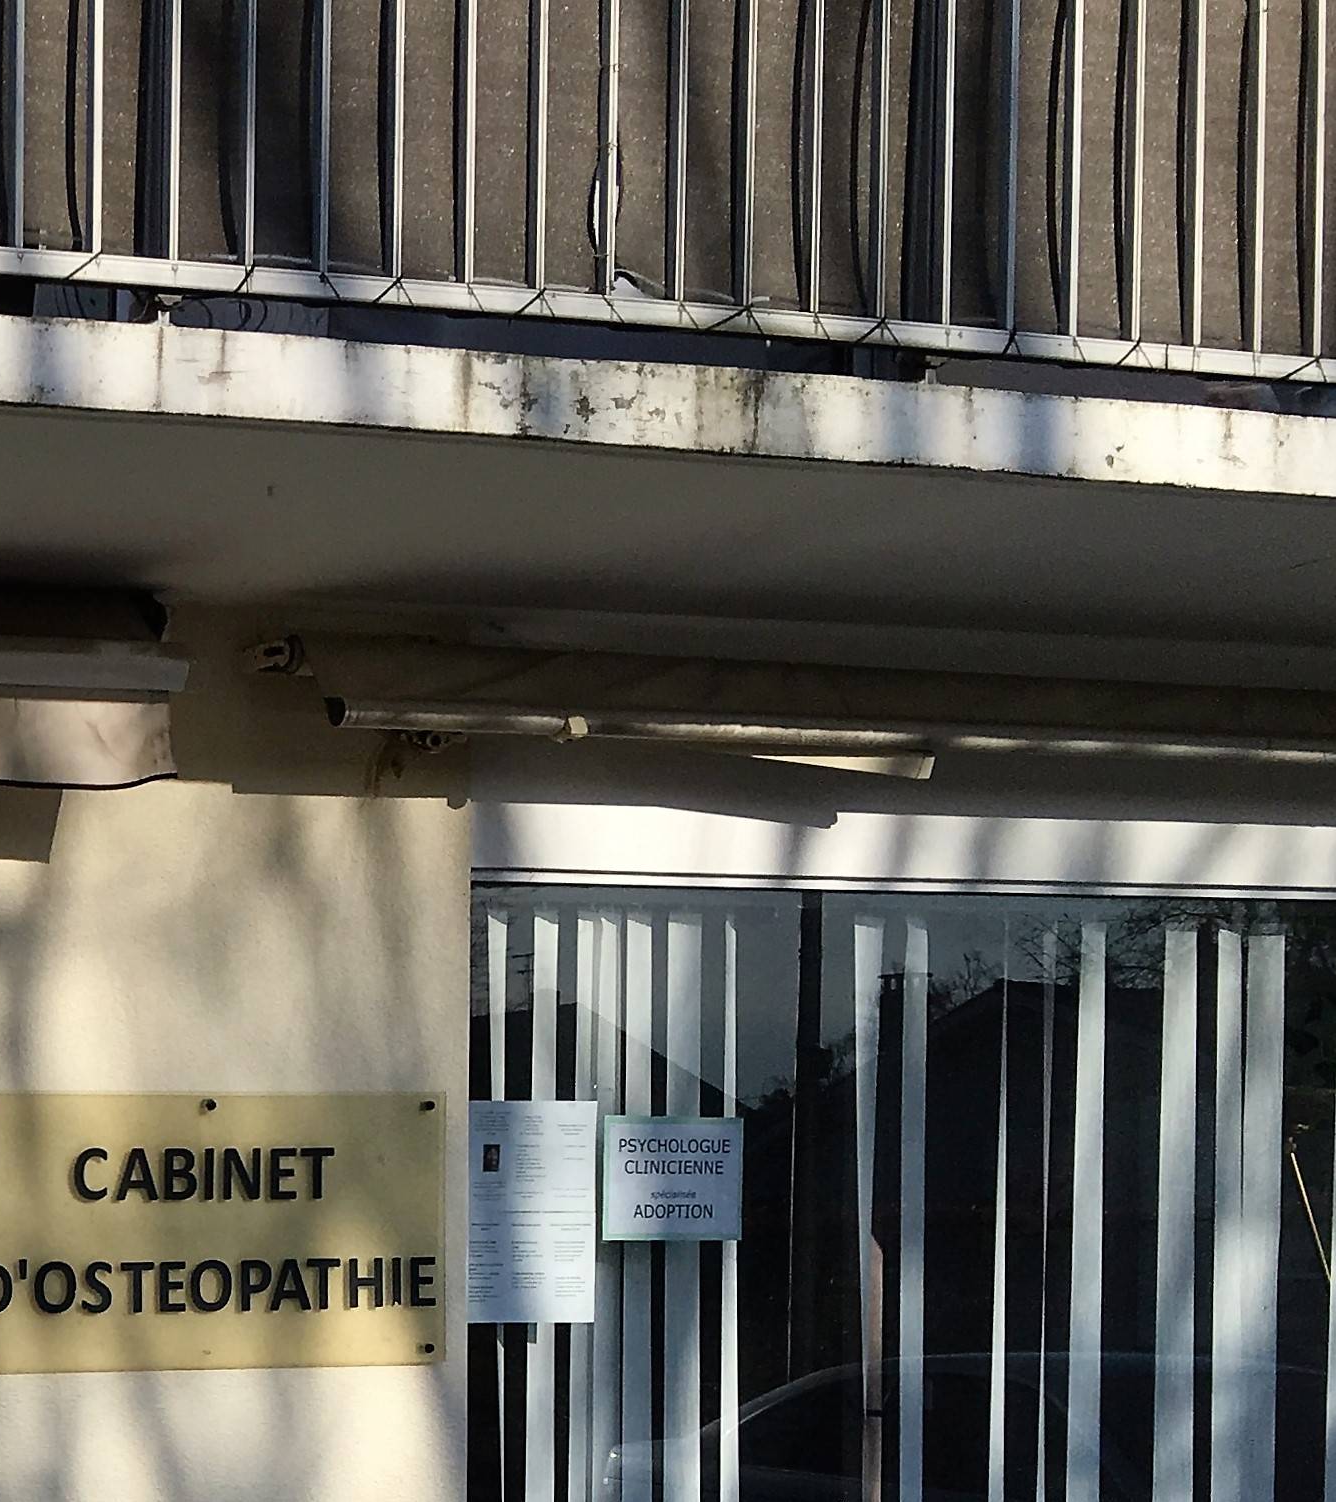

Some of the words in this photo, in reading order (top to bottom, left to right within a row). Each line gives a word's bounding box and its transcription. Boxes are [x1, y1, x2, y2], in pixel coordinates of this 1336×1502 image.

[618, 1138, 731, 1154] PSYCHOLOGUE
[72, 1146, 335, 1202] CABINET
[624, 1159, 725, 1175] CLINICIENNE
[633, 1203, 714, 1219] ADOPTION
